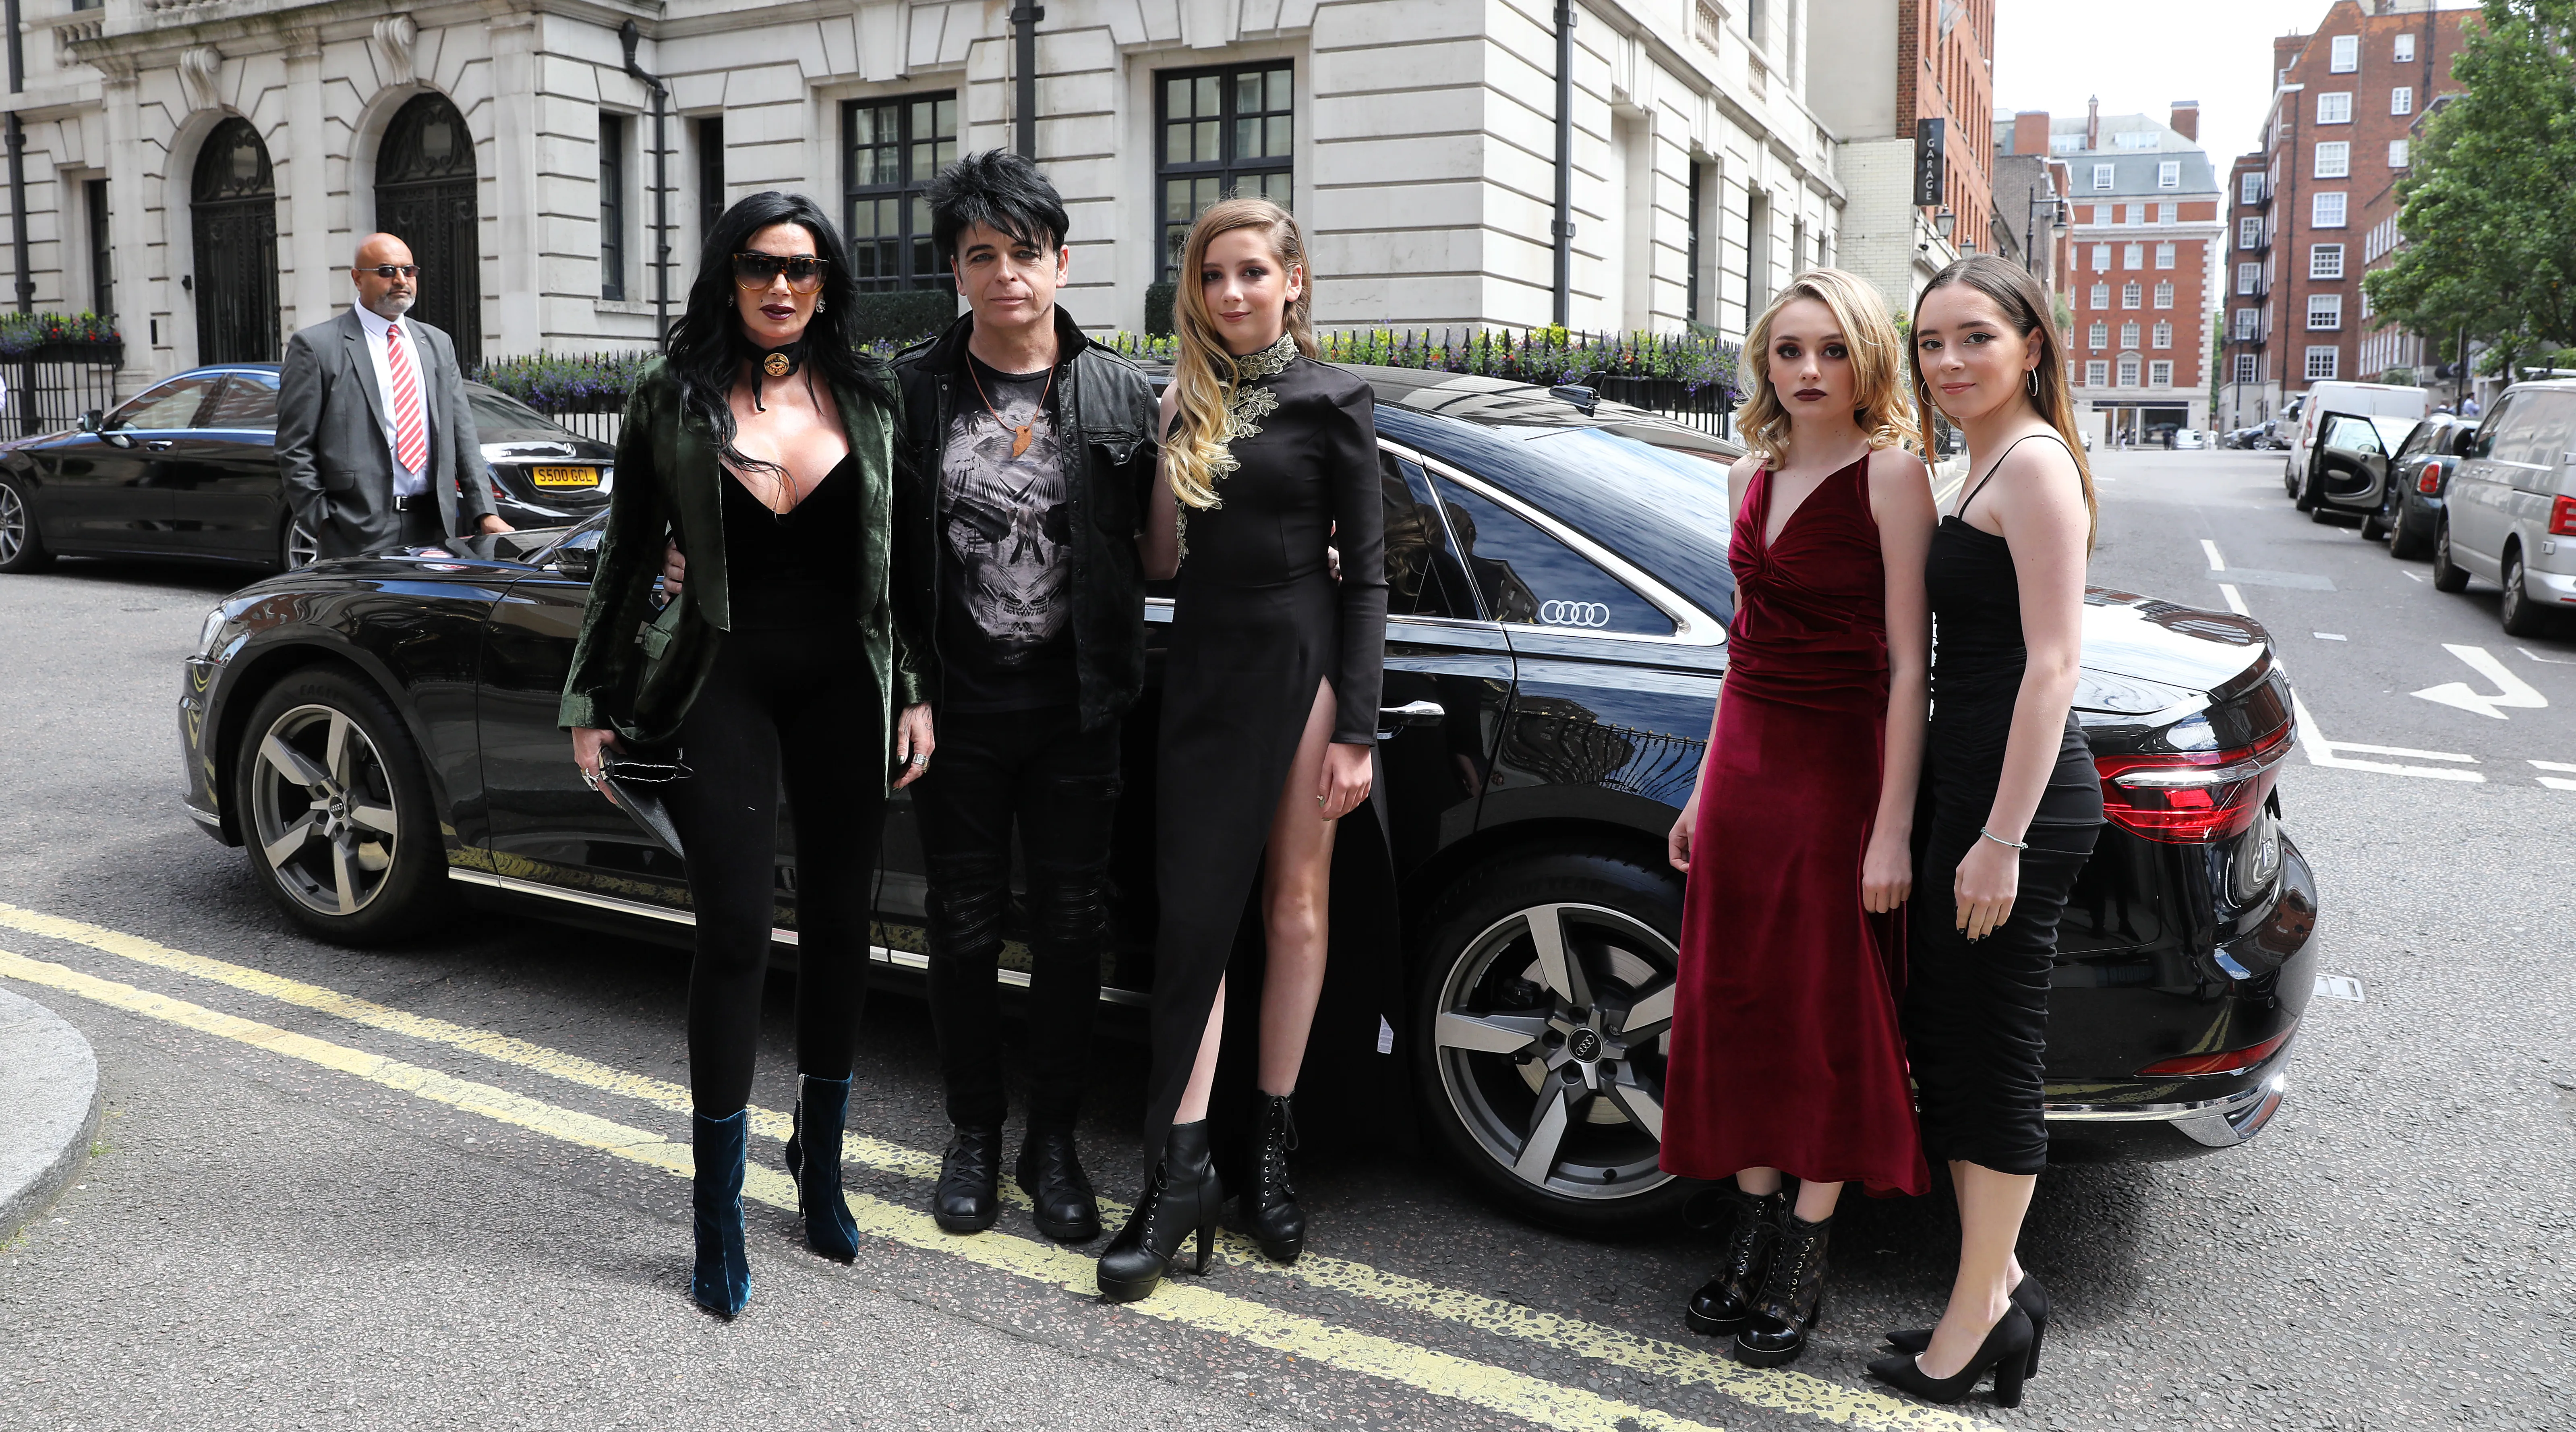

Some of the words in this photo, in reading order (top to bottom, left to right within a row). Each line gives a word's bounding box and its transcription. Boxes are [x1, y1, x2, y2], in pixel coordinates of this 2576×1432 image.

[1925, 138, 1935, 200] GARAGE
[538, 468, 568, 482] S500
[571, 468, 592, 482] GCL
